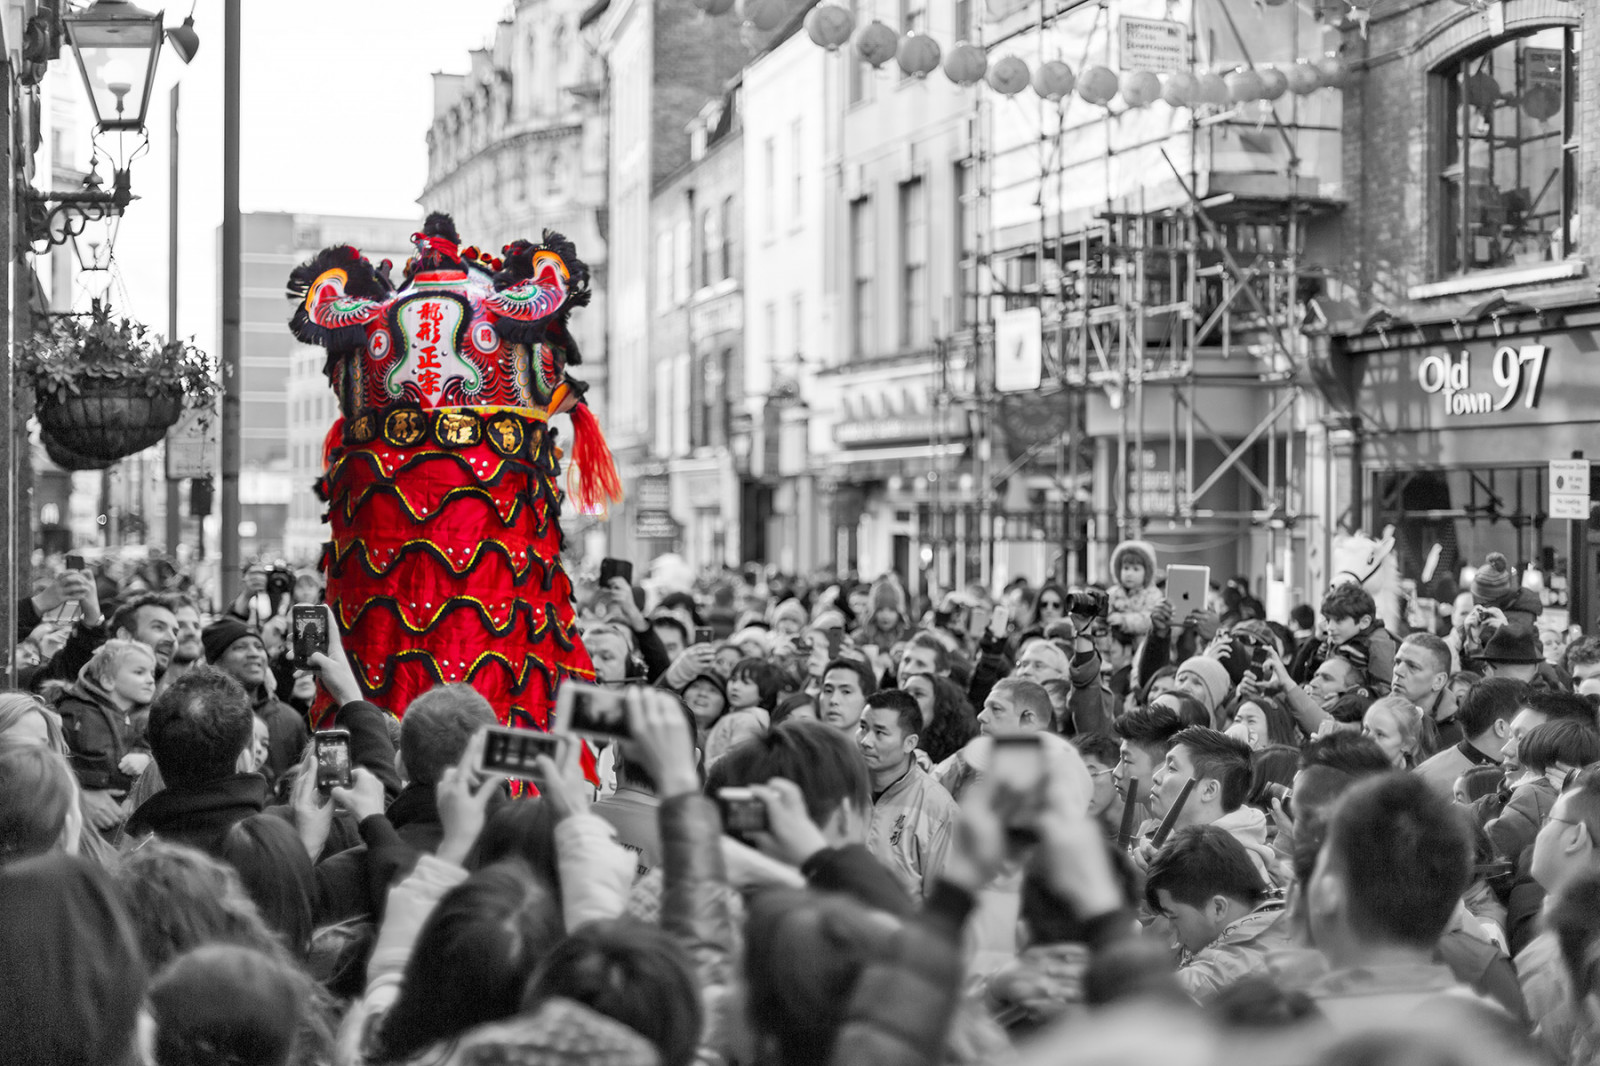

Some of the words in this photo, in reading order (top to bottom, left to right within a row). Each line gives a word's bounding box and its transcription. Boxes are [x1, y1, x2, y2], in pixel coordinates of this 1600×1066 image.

[416, 302, 443, 395] 龍形正宗
[1418, 350, 1469, 393] Old
[1442, 387, 1492, 415] Town
[1492, 345, 1545, 411] 97
